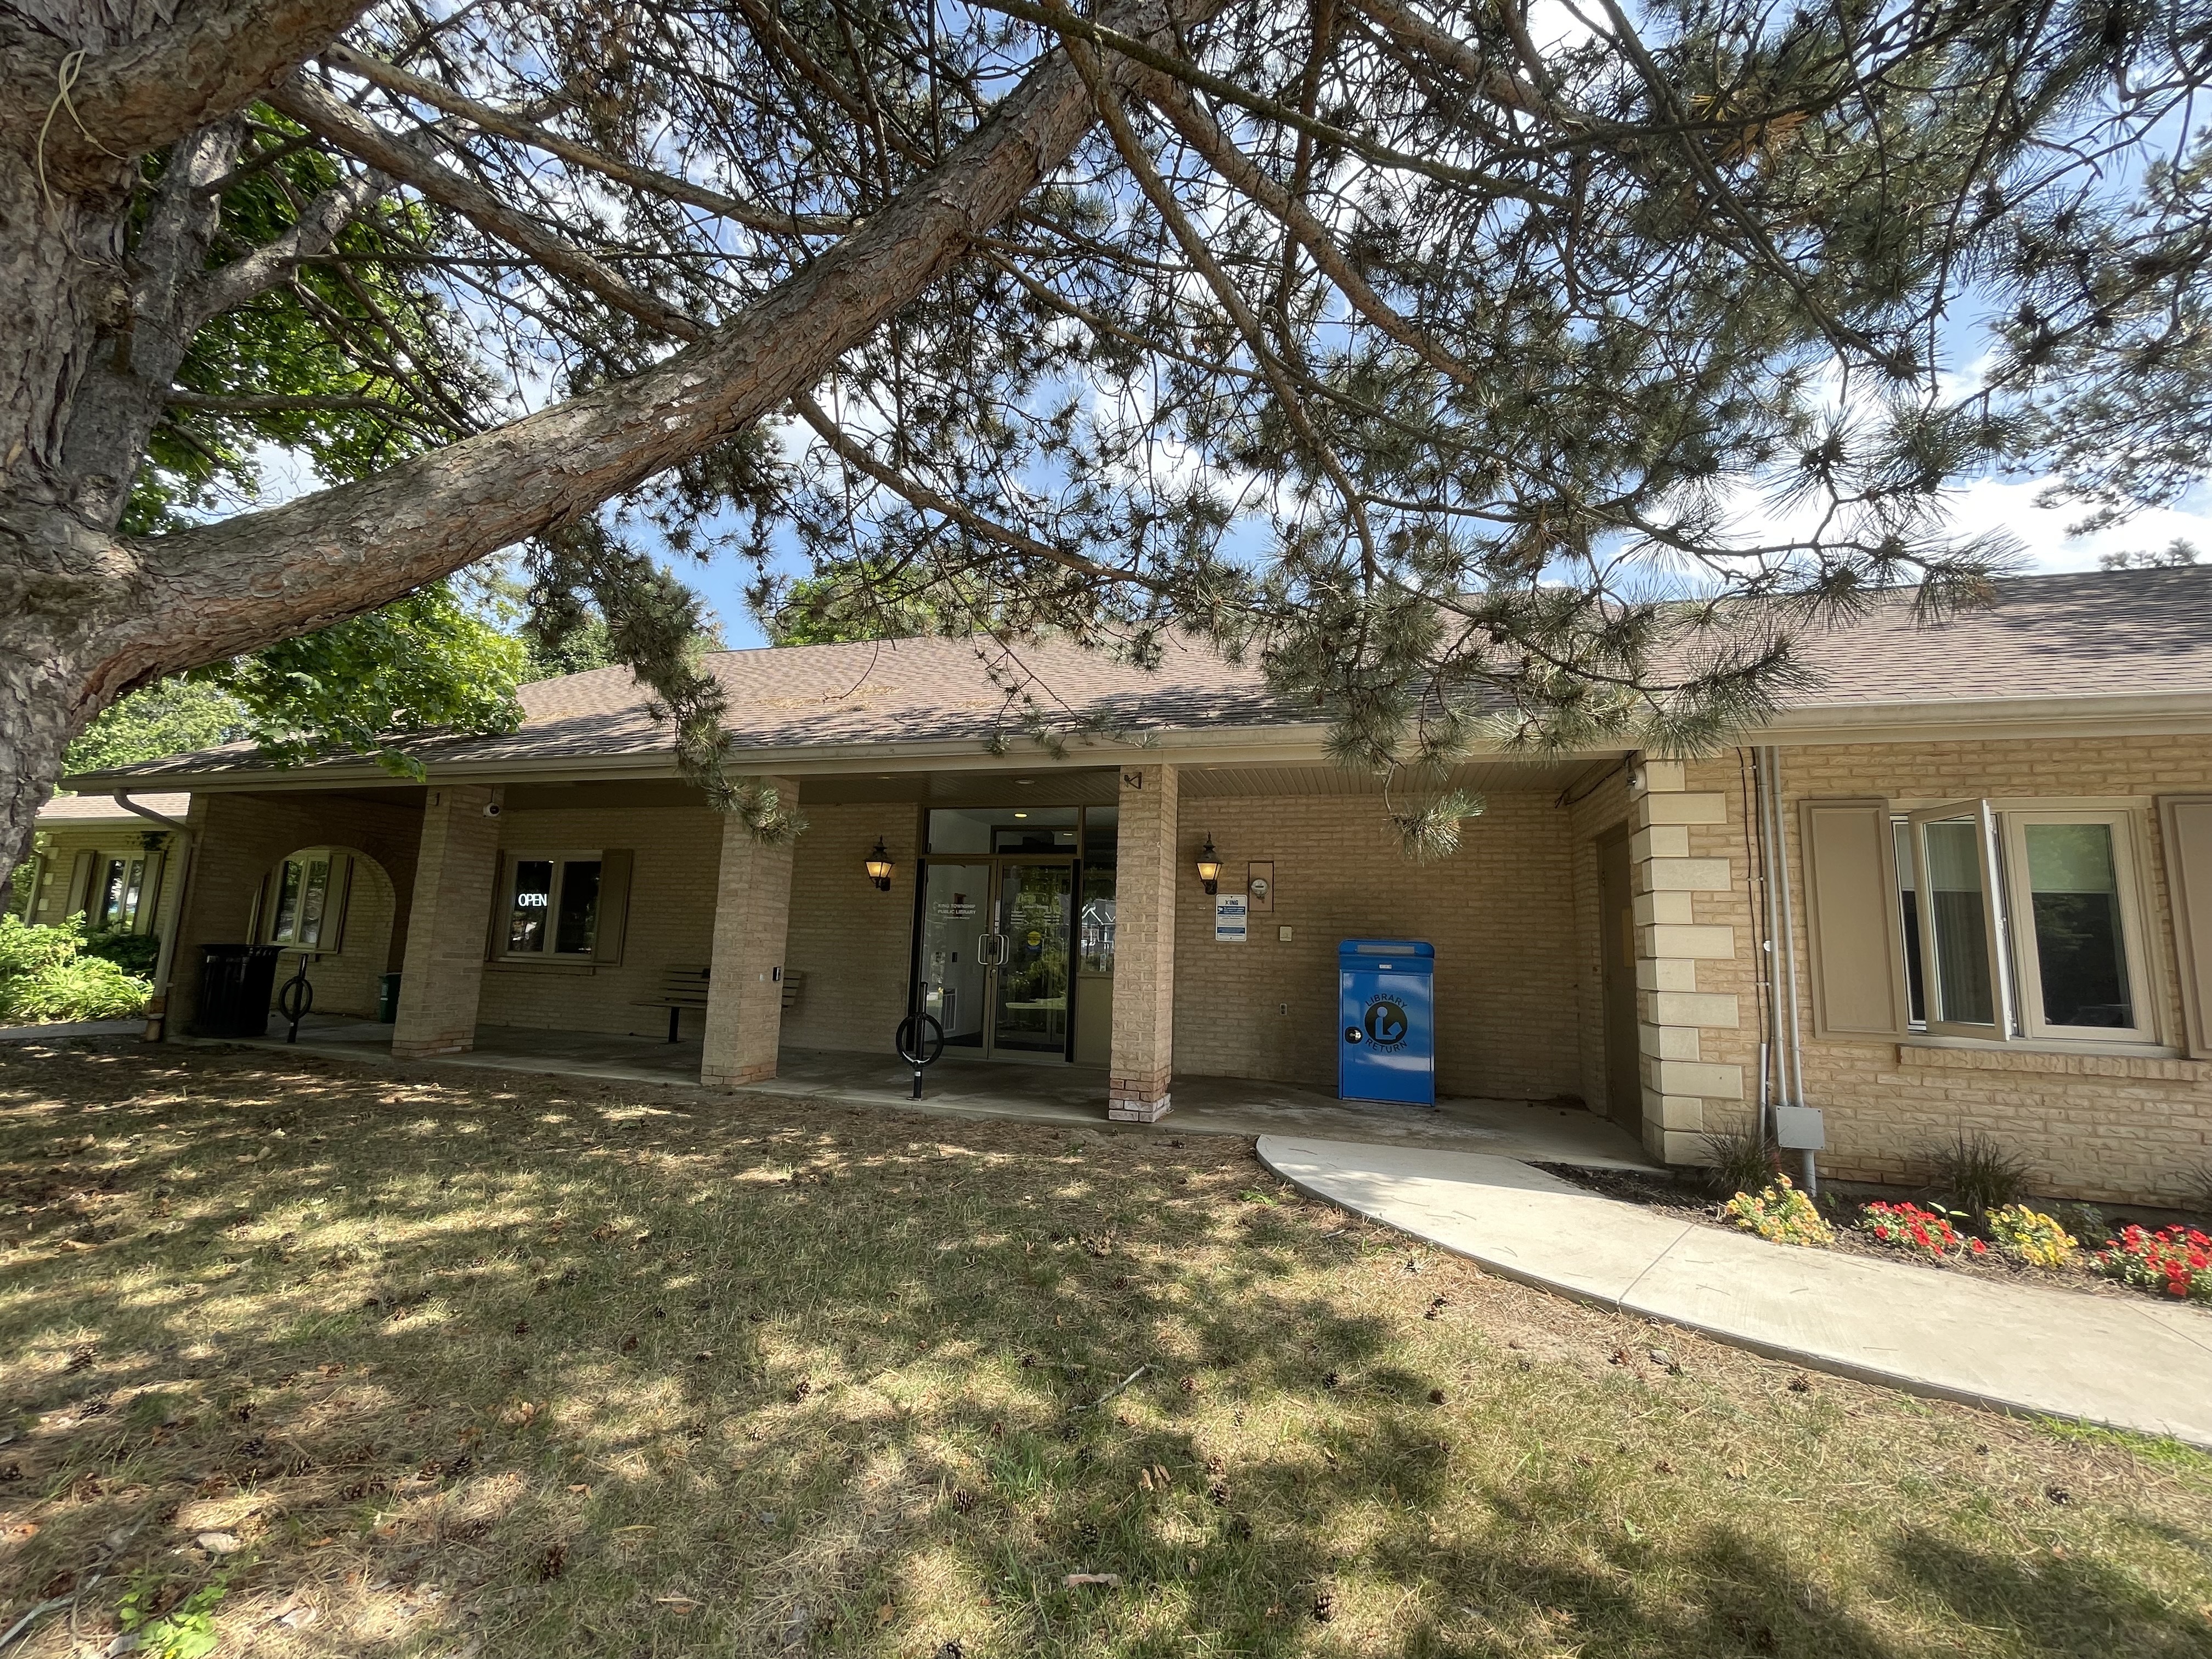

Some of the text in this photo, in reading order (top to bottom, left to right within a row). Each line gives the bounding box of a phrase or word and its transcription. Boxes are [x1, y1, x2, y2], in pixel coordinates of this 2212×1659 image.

[518, 893, 548, 906] OPEN
[1365, 993, 1408, 1008] LIBRARY
[1365, 1037, 1408, 1053] RETURN
